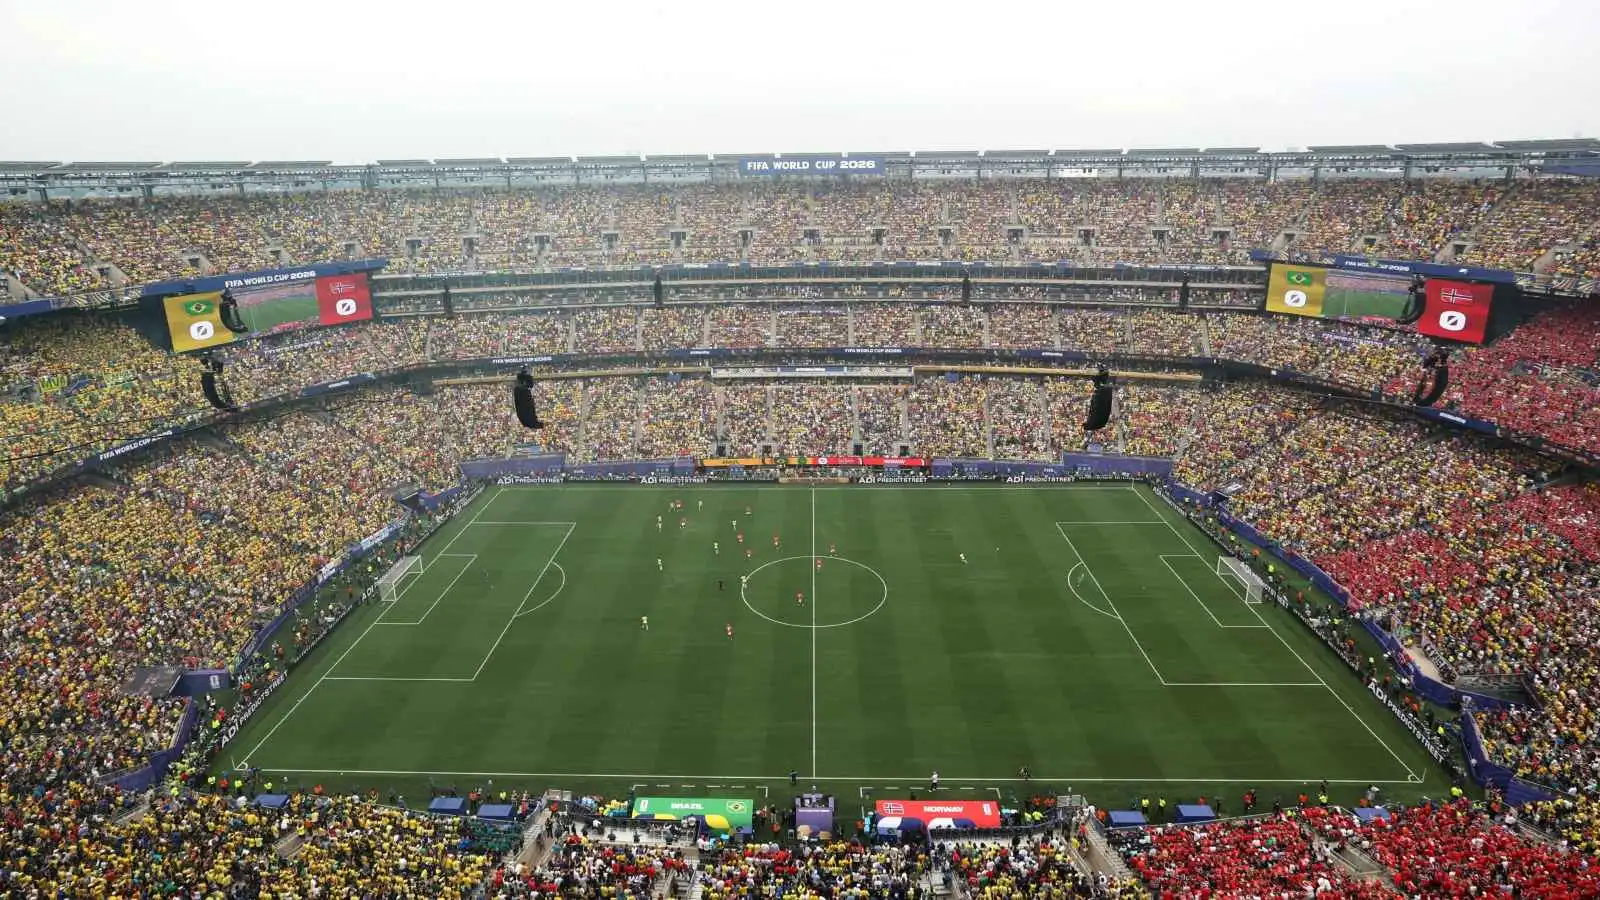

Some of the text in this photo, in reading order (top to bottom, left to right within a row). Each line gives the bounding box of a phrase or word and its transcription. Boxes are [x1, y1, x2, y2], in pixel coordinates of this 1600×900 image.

[747, 160, 876, 171] FIFA WORLD CUP 2026
[225, 270, 316, 288] FIFA WORLD CUP 2026
[100, 451, 115, 460] FIFA
[115, 442, 139, 455] WORLD
[139, 438, 151, 446] CUP
[640, 476, 658, 484] ADI
[859, 476, 876, 484] ADI
[1006, 475, 1024, 483] ADI
[1367, 681, 1388, 704] ADI
[1387, 700, 1445, 763] PREDICTSTREET
[221, 718, 239, 748] ADI
[923, 805, 964, 813] NORWAY
